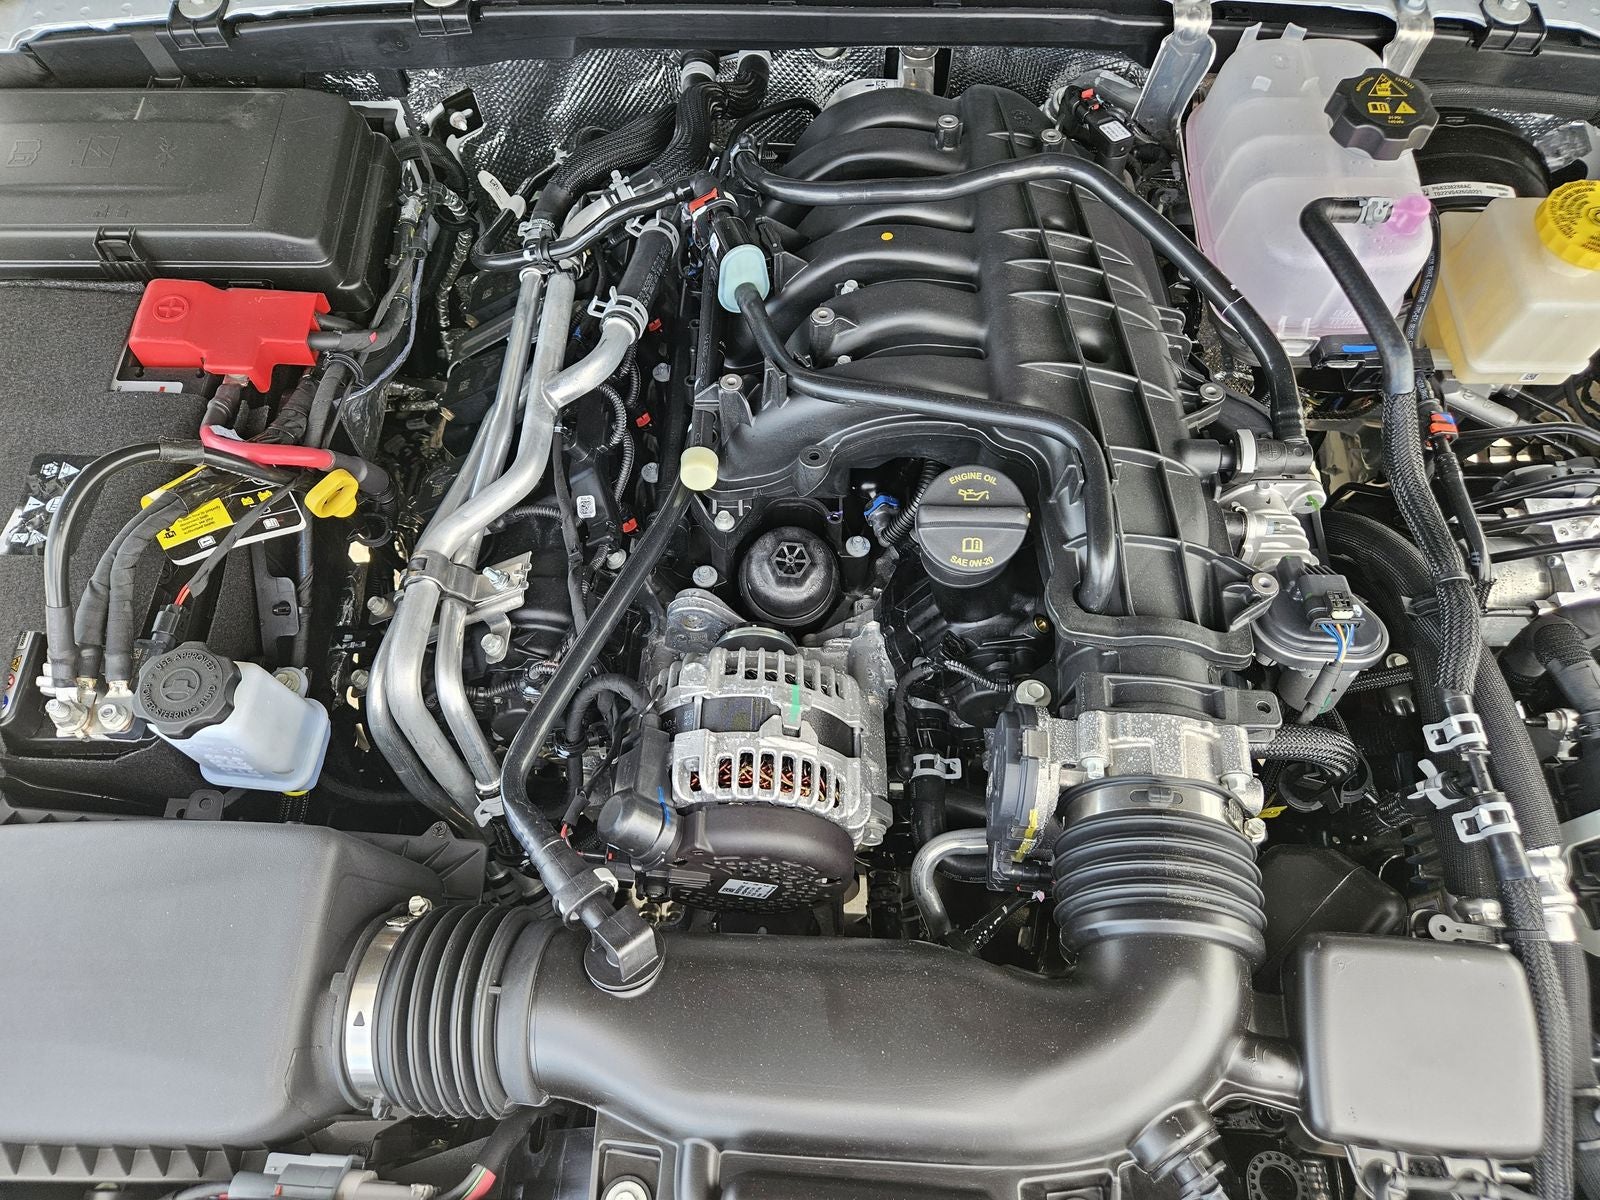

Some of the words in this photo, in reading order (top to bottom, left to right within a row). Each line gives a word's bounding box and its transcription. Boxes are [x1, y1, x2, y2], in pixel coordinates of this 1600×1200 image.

[949, 471, 983, 485] ENGINE
[983, 474, 997, 486] OIL
[950, 555, 969, 567] SAE
[155, 657, 172, 670] USE
[173, 652, 215, 671] APPROVED
[143, 683, 158, 711] POWER
[155, 705, 199, 719] STEERING
[199, 684, 217, 707] FLUID
